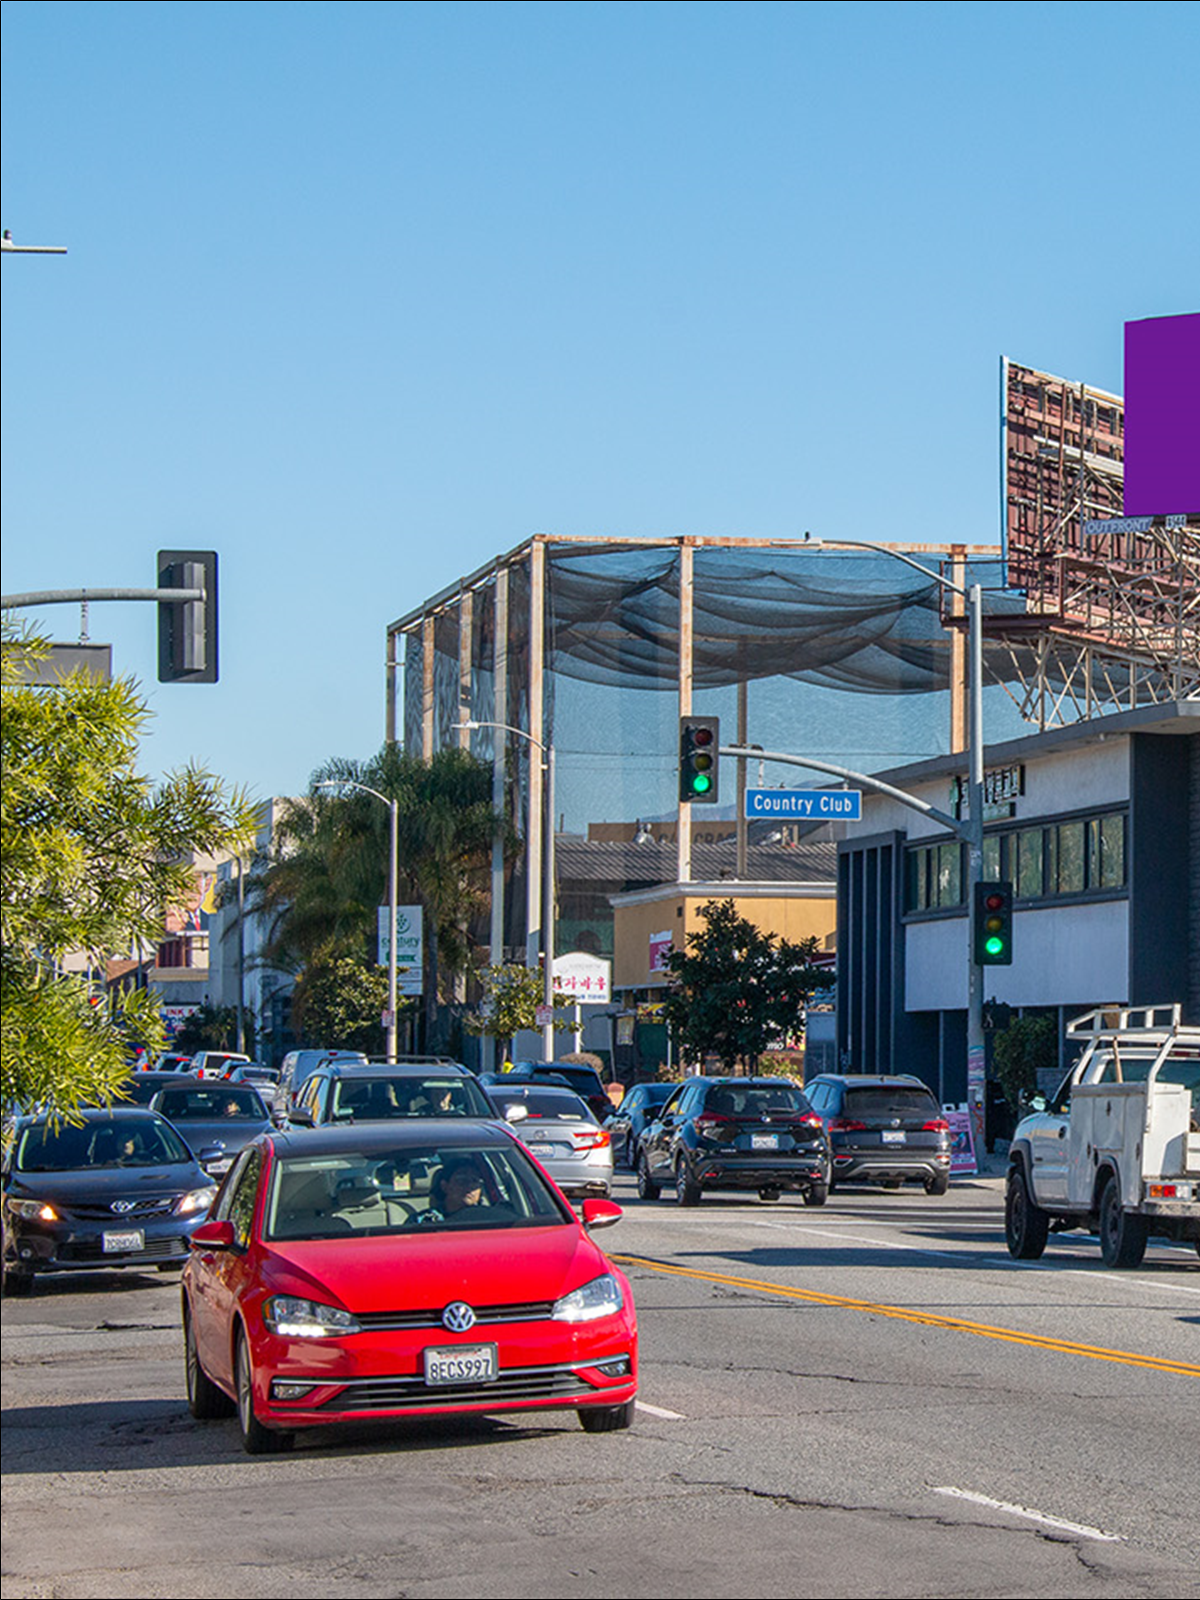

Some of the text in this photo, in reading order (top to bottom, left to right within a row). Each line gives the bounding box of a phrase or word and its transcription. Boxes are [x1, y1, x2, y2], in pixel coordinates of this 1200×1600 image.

[1088, 520, 1150, 533] OUTFRONT
[754, 794, 852, 815] Country Club
[430, 1358, 490, 1380] 8ECS997
